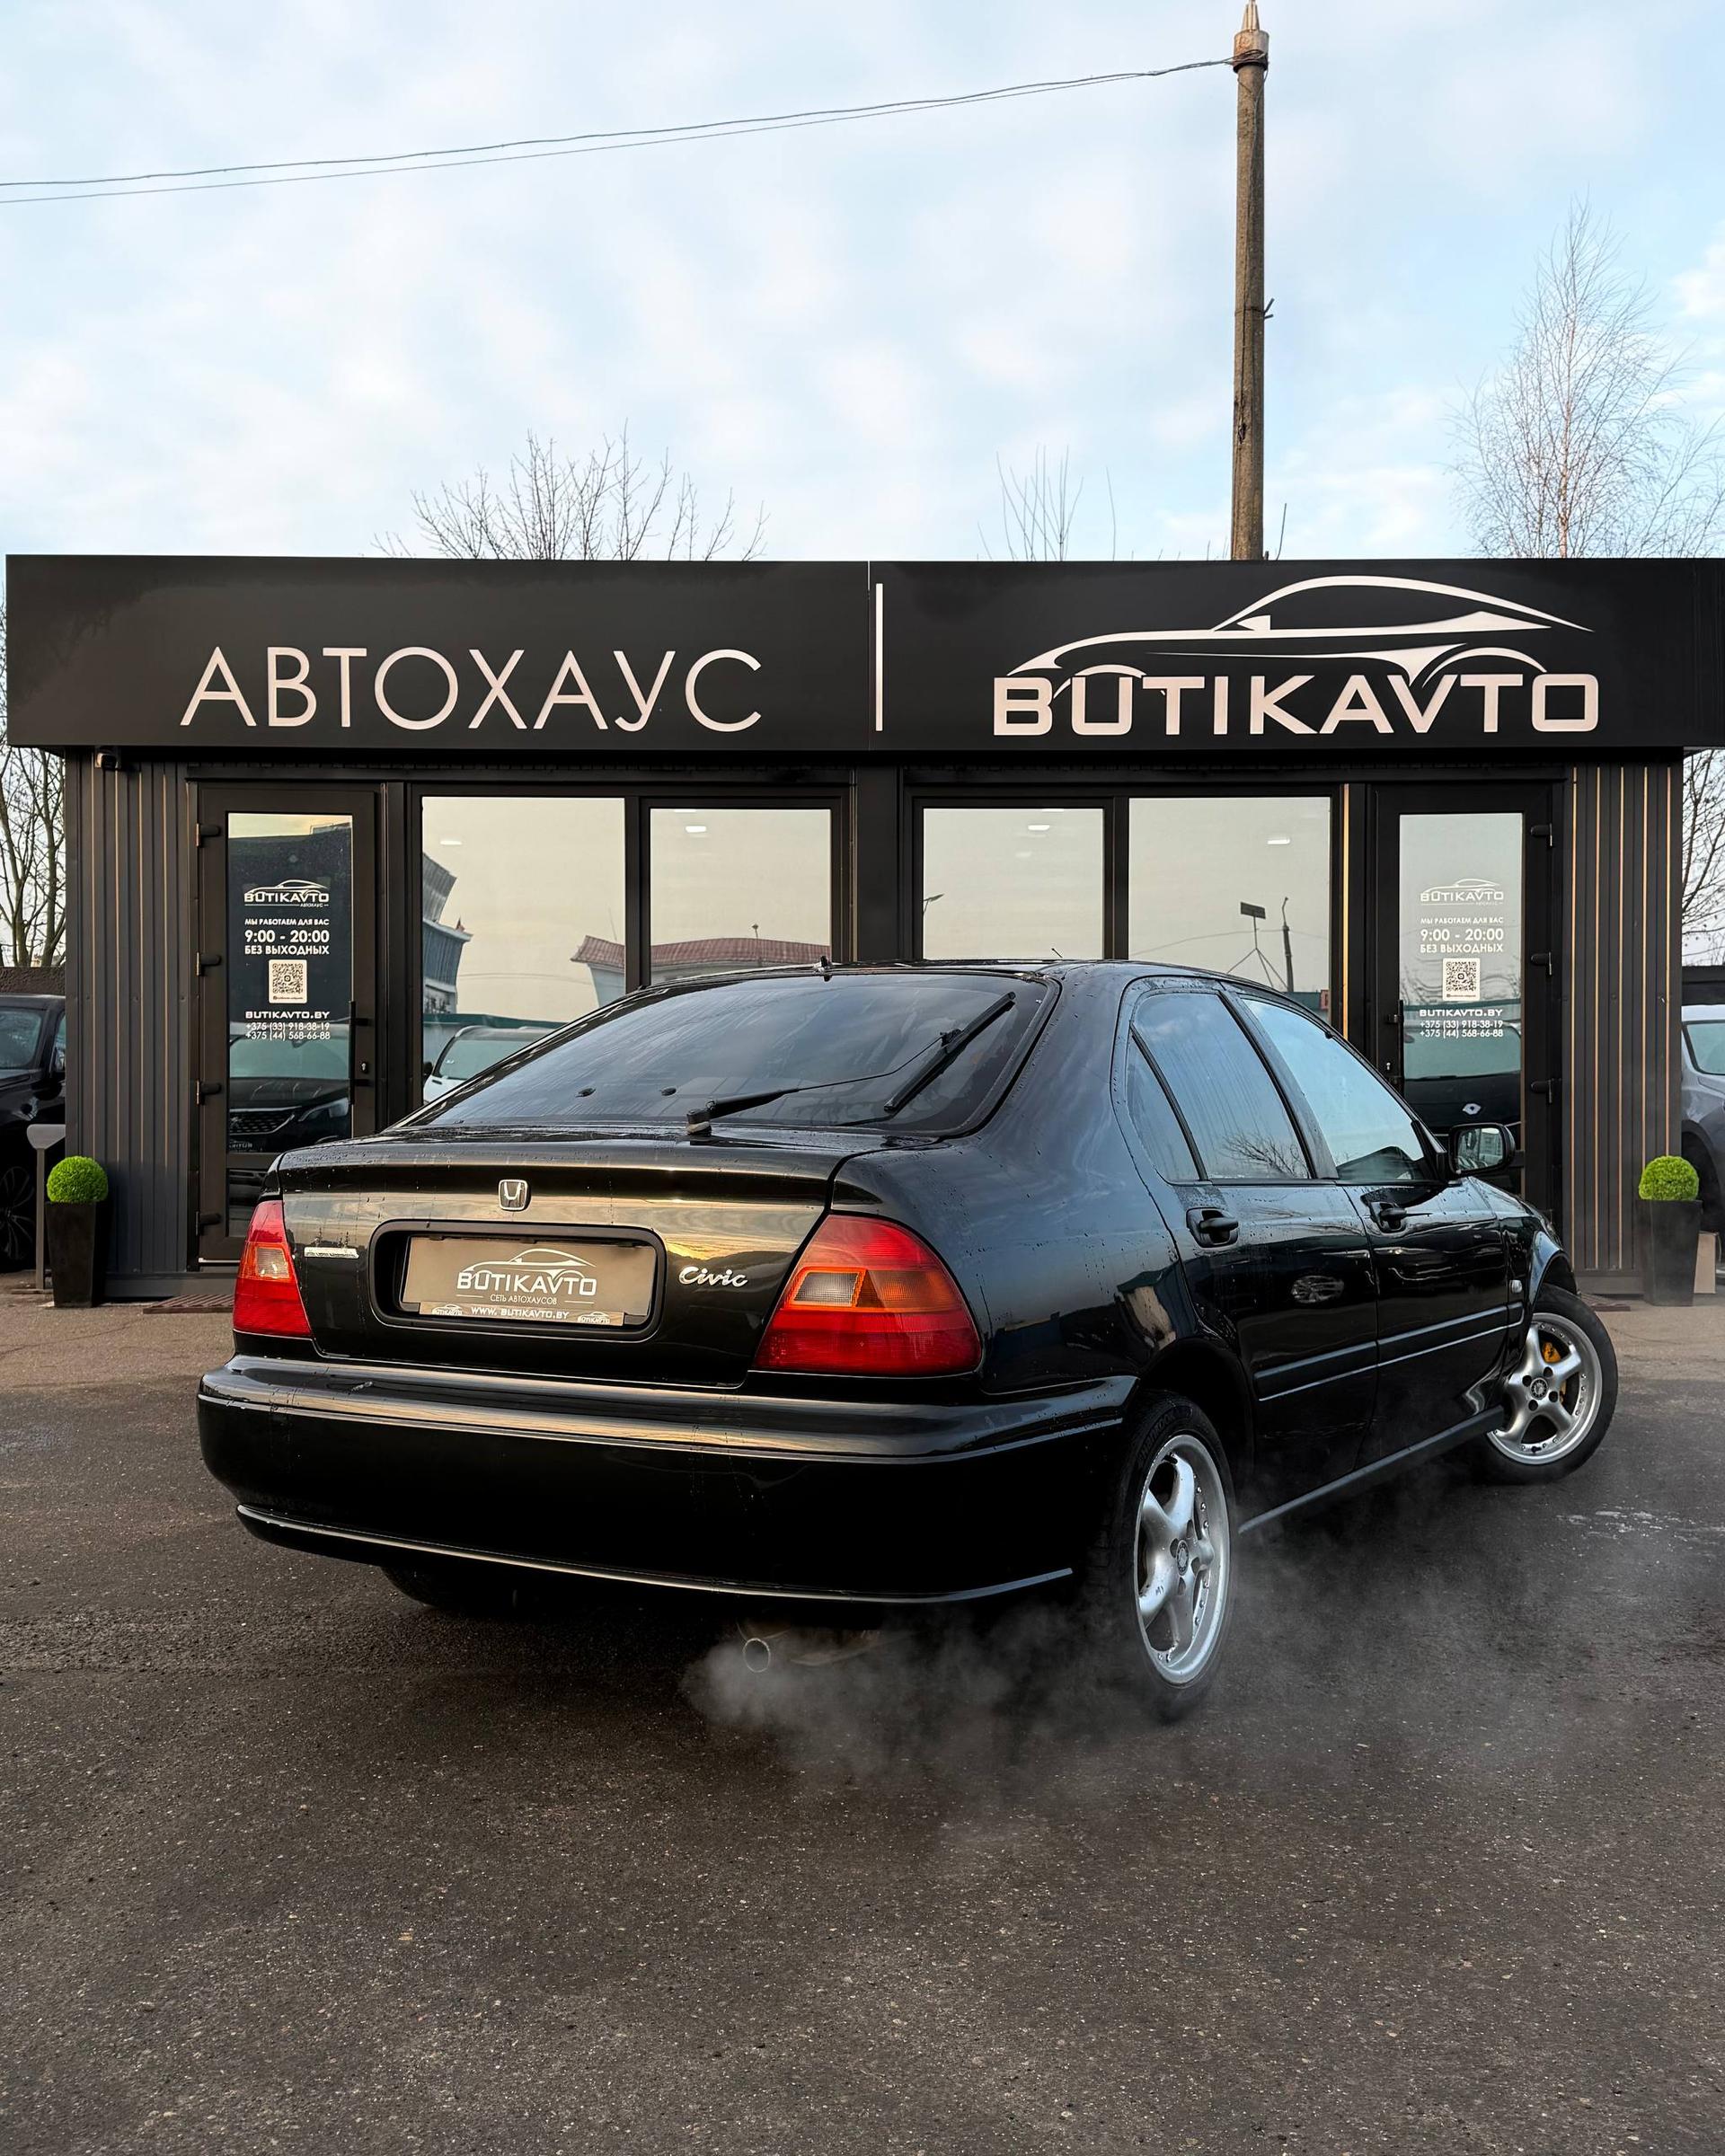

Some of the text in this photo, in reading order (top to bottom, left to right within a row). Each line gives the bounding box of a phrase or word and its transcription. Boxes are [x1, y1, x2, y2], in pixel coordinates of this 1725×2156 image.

[180, 646, 762, 732] АВТОХАУС
[994, 673, 1599, 736] BUTIKAVTO
[244, 892, 330, 903] BUTIKAVTO
[1420, 891, 1504, 901] BUTIKAVTO
[297, 918, 313, 926] ДЛЯ
[244, 930, 276, 942] 9:00
[289, 930, 330, 942] 20:00
[1420, 928, 1450, 941] 9:00
[1464, 928, 1504, 941] 20:00
[244, 944, 330, 956] БЕЗ ВЫХОДНЫХ
[1420, 943, 1503, 954] БЕЗ ВЫХОДНЫХ
[245, 1011, 330, 1019] BUTIKAVTO.BY
[1419, 1009, 1503, 1017] BUTIKAVTO.BY
[245, 1022, 331, 1031] +375 (33) 918-38-19
[1420, 1020, 1504, 1029] +375 (33) 918-38-19
[245, 1031, 331, 1041] +375 (44) 568-66-88
[1420, 1029, 1504, 1038] +375 (44) 568-66-88
[678, 1266, 748, 1287] Civic
[456, 1271, 597, 1296] BUTIKAVTO
[490, 1294, 557, 1305] СЕТЬ АВТОХАУСОВ
[471, 1306, 570, 1320] WWW. BUTIKAVTO.BY
